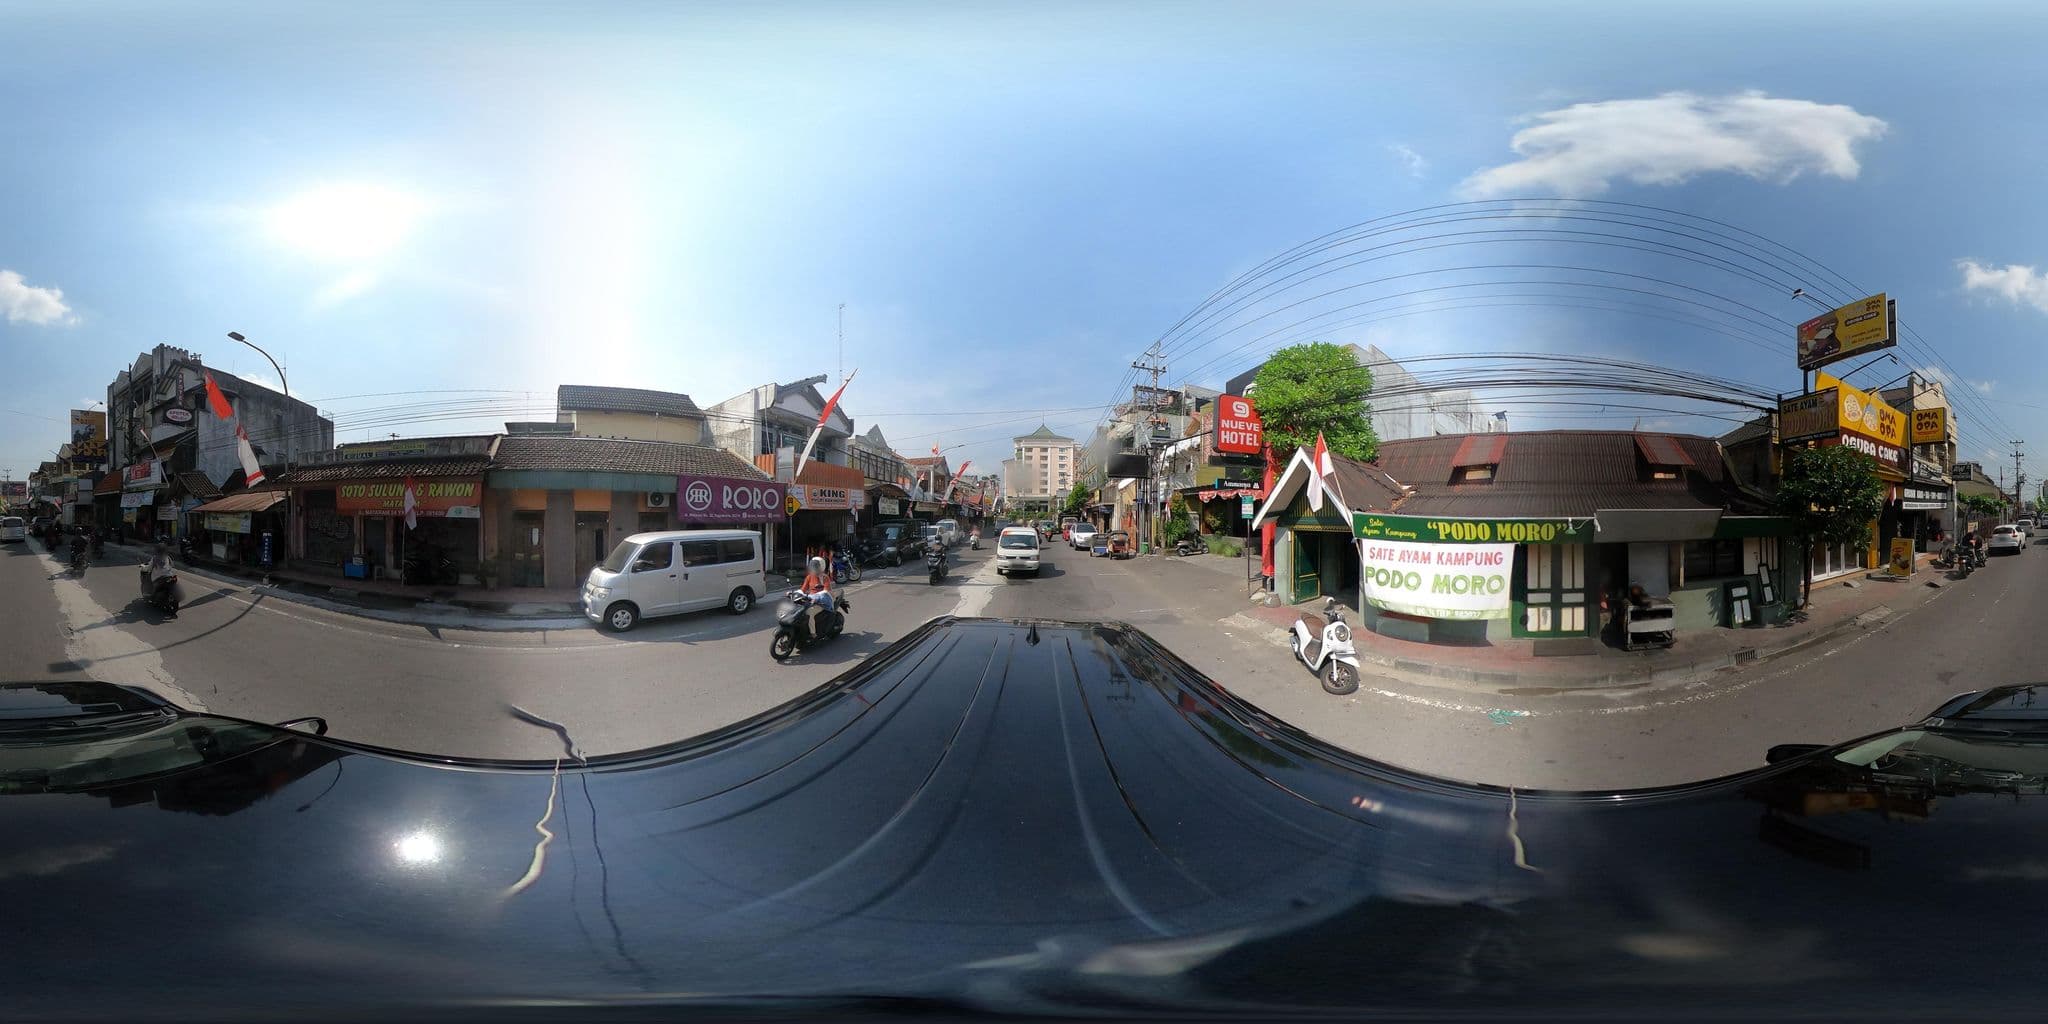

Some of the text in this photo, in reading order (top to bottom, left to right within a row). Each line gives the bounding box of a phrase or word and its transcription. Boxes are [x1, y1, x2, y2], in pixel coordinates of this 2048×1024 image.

[1879, 409, 1897, 428] OMA
[1916, 412, 1938, 421] OMA
[1221, 419, 1260, 432] NUEVE
[1879, 423, 1897, 439] OPA
[1916, 421, 1938, 431] OPA
[1221, 430, 1259, 446] HOTEL
[1841, 434, 1876, 457] OGURA
[1878, 446, 1898, 463] CAKE
[341, 483, 475, 497] SOTO SULUN & RAWON
[722, 485, 780, 510] RORO
[820, 489, 845, 498] KING
[1362, 526, 1418, 539] Ayam Kampung
[1369, 547, 1504, 566] SATE AYAM KAMPUNG
[1364, 566, 1506, 596] PODO MORO
